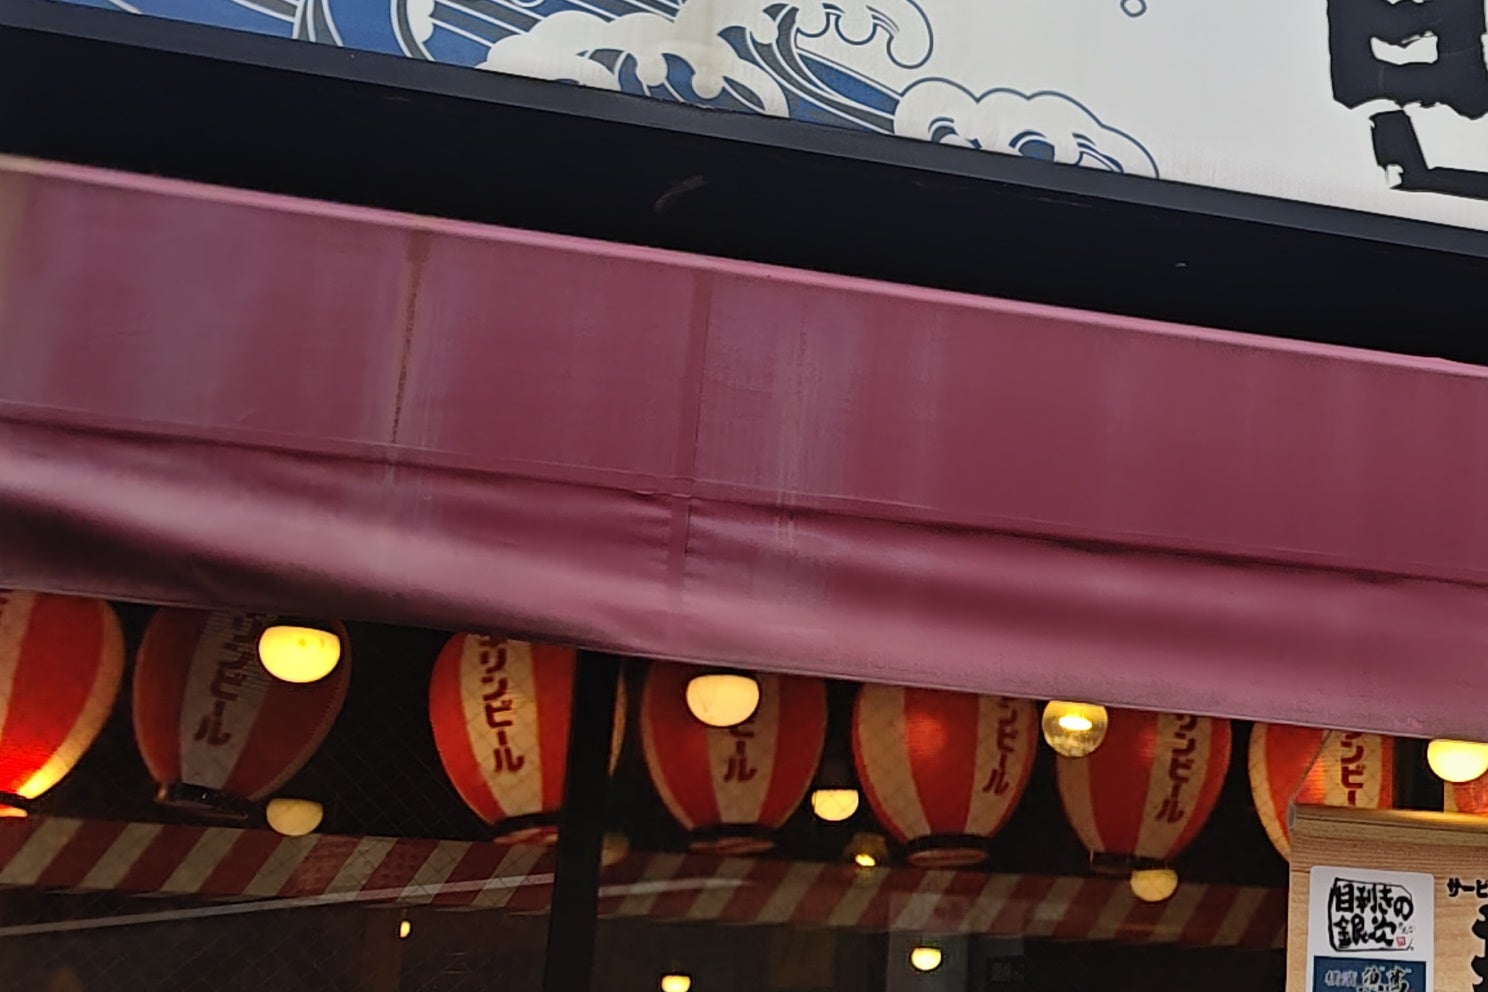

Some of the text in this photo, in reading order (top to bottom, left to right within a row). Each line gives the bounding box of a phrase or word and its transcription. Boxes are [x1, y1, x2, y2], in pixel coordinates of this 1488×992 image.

[1333, 883, 1414, 922] 目利きの
[1332, 914, 1398, 949] 銀次
